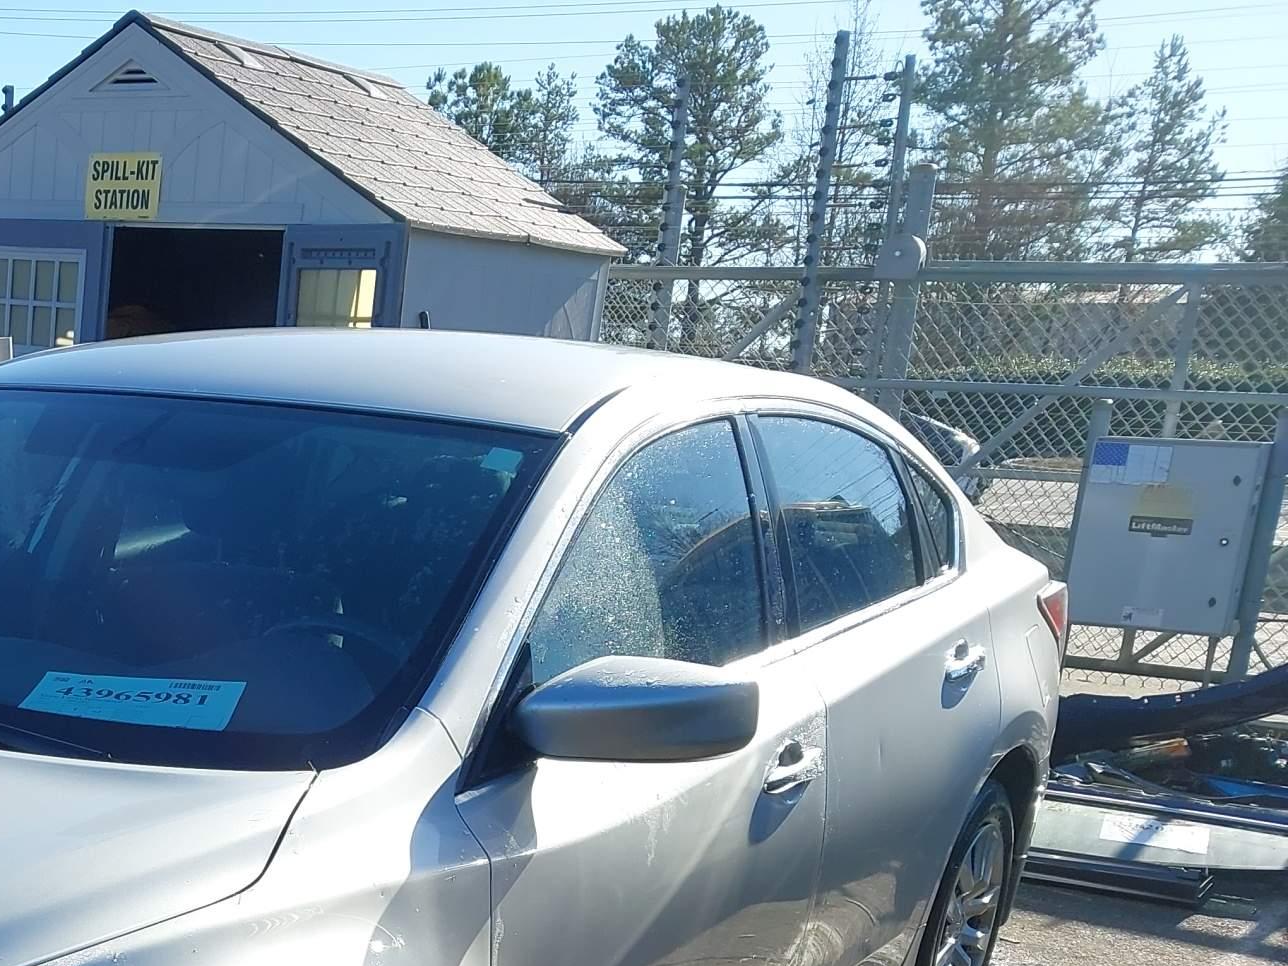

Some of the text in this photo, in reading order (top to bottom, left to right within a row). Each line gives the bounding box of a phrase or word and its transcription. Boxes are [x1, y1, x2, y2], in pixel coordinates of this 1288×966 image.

[92, 160, 159, 181] SPILL-KIT
[94, 189, 150, 210] STATION
[1131, 521, 1189, 533] LiftMaster
[55, 686, 210, 706] 43965981
